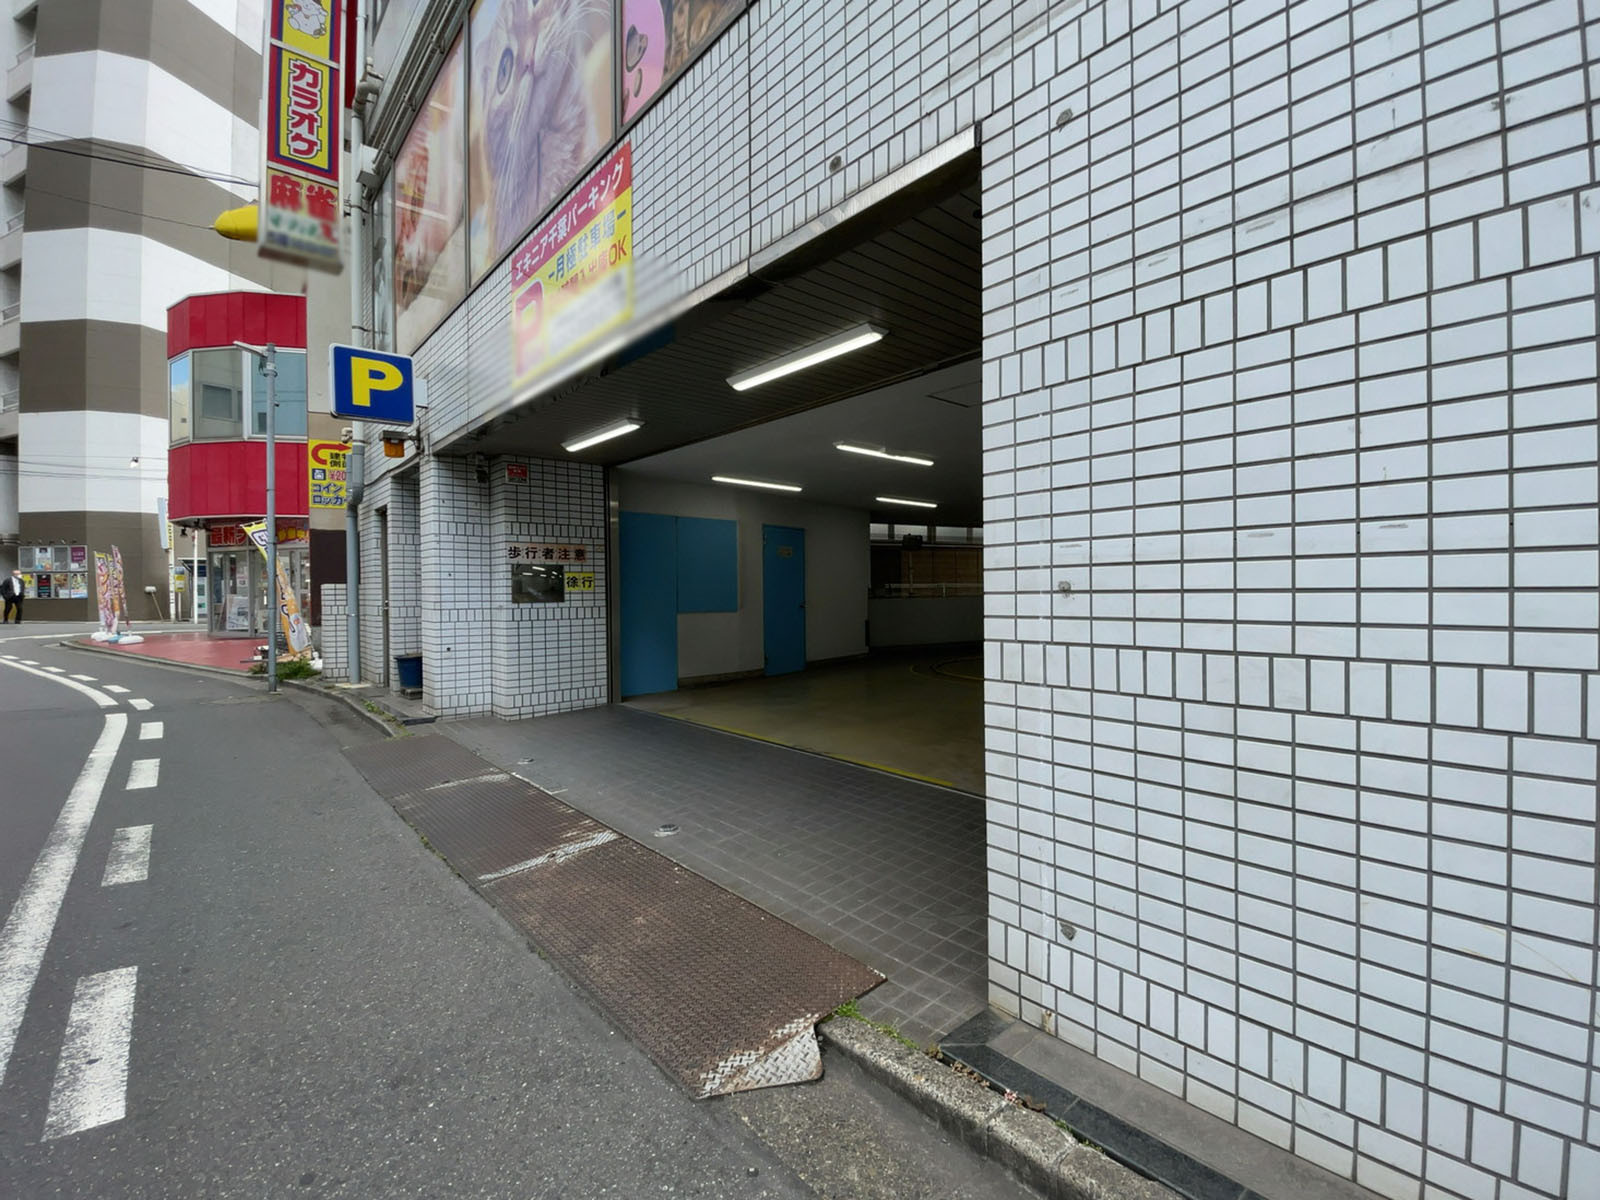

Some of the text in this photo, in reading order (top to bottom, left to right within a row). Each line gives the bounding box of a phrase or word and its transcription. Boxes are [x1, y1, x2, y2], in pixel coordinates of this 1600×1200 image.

[291, 61, 319, 157] カラオケ
[270, 174, 336, 223] 麻雀
[350, 356, 404, 407] P
[312, 482, 343, 494] コイン
[508, 545, 586, 561] 歩行者注意
[566, 575, 593, 588] 徐行
